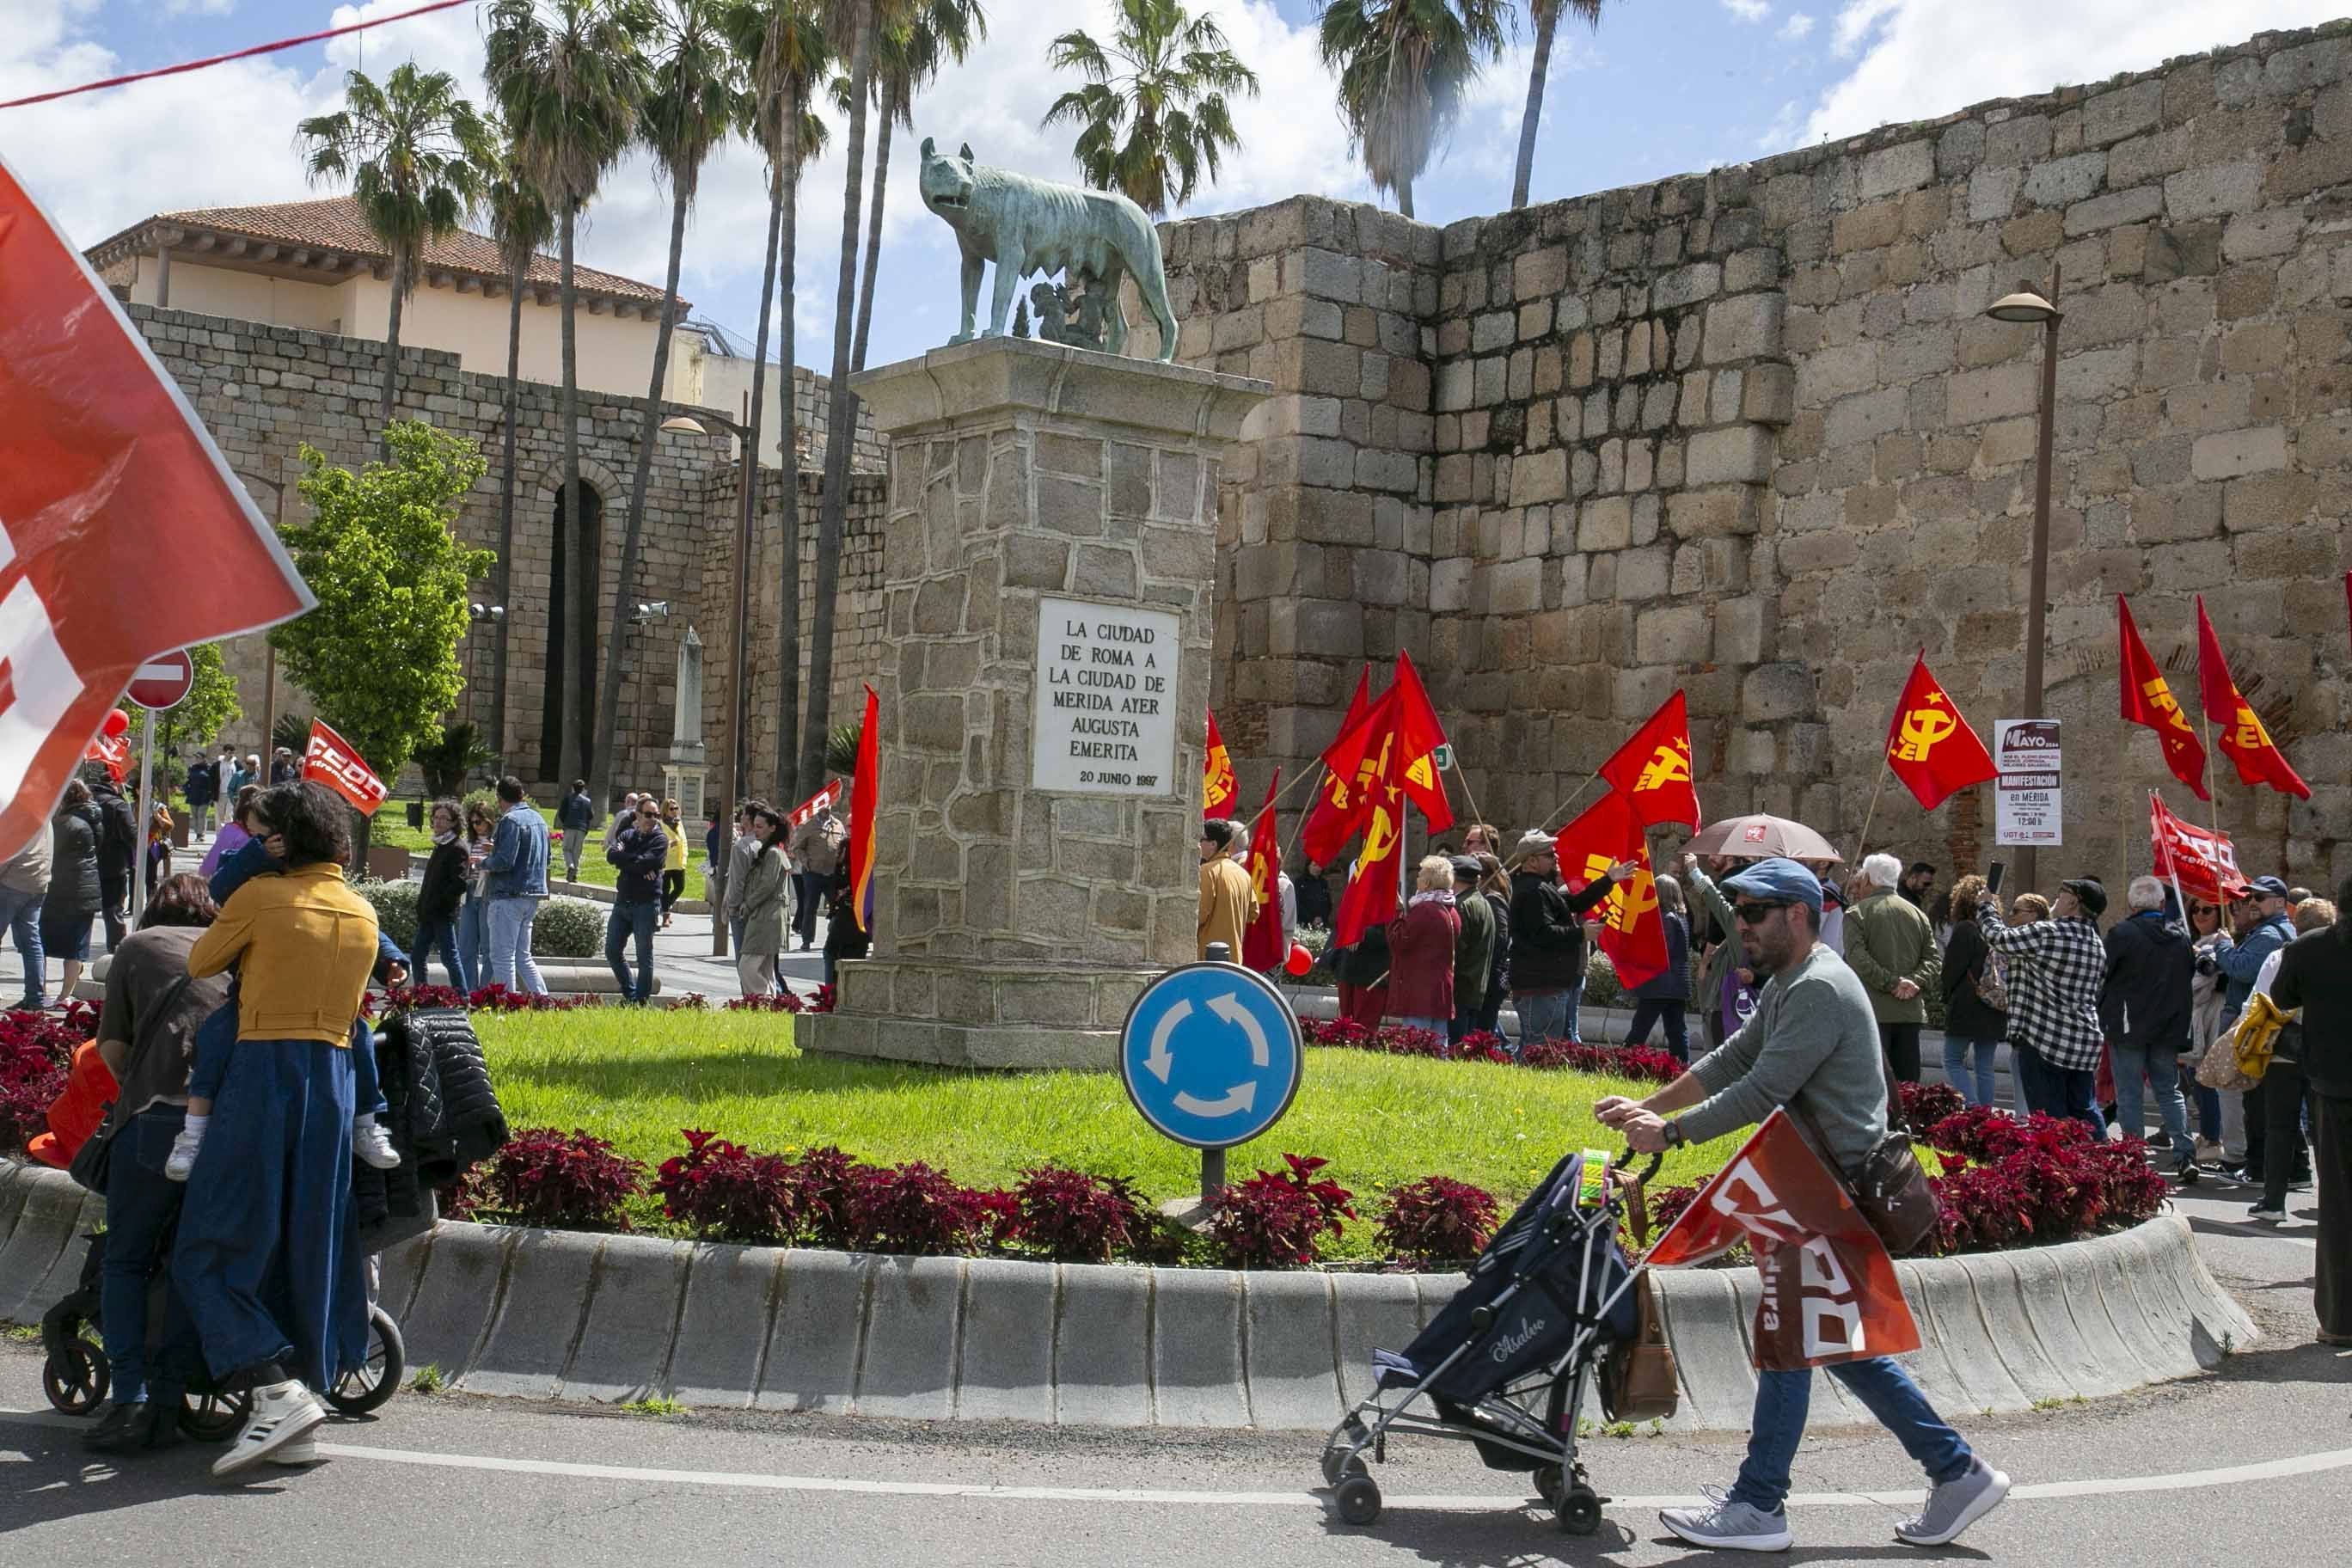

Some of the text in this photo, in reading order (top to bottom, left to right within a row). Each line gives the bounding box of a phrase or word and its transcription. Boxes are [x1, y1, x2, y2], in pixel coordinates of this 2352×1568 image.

[1066, 620, 1155, 644] LA CIUDAD
[1061, 644, 1156, 668] DE ROMA A
[1049, 667, 1165, 693] LA CIUDAD DE
[1053, 691, 1160, 714] MERIDA AYER
[1071, 717, 1140, 738] AUGUSTA
[1069, 740, 1138, 762] EMERITA
[1080, 770, 1158, 787] 20 JUNIO 1997
[2001, 774, 2057, 787] MANIFESTACIÓN
[2010, 793, 2020, 801] en
[2018, 817, 2037, 826] 12:00
[1489, 1317, 1546, 1362] Asalvo
